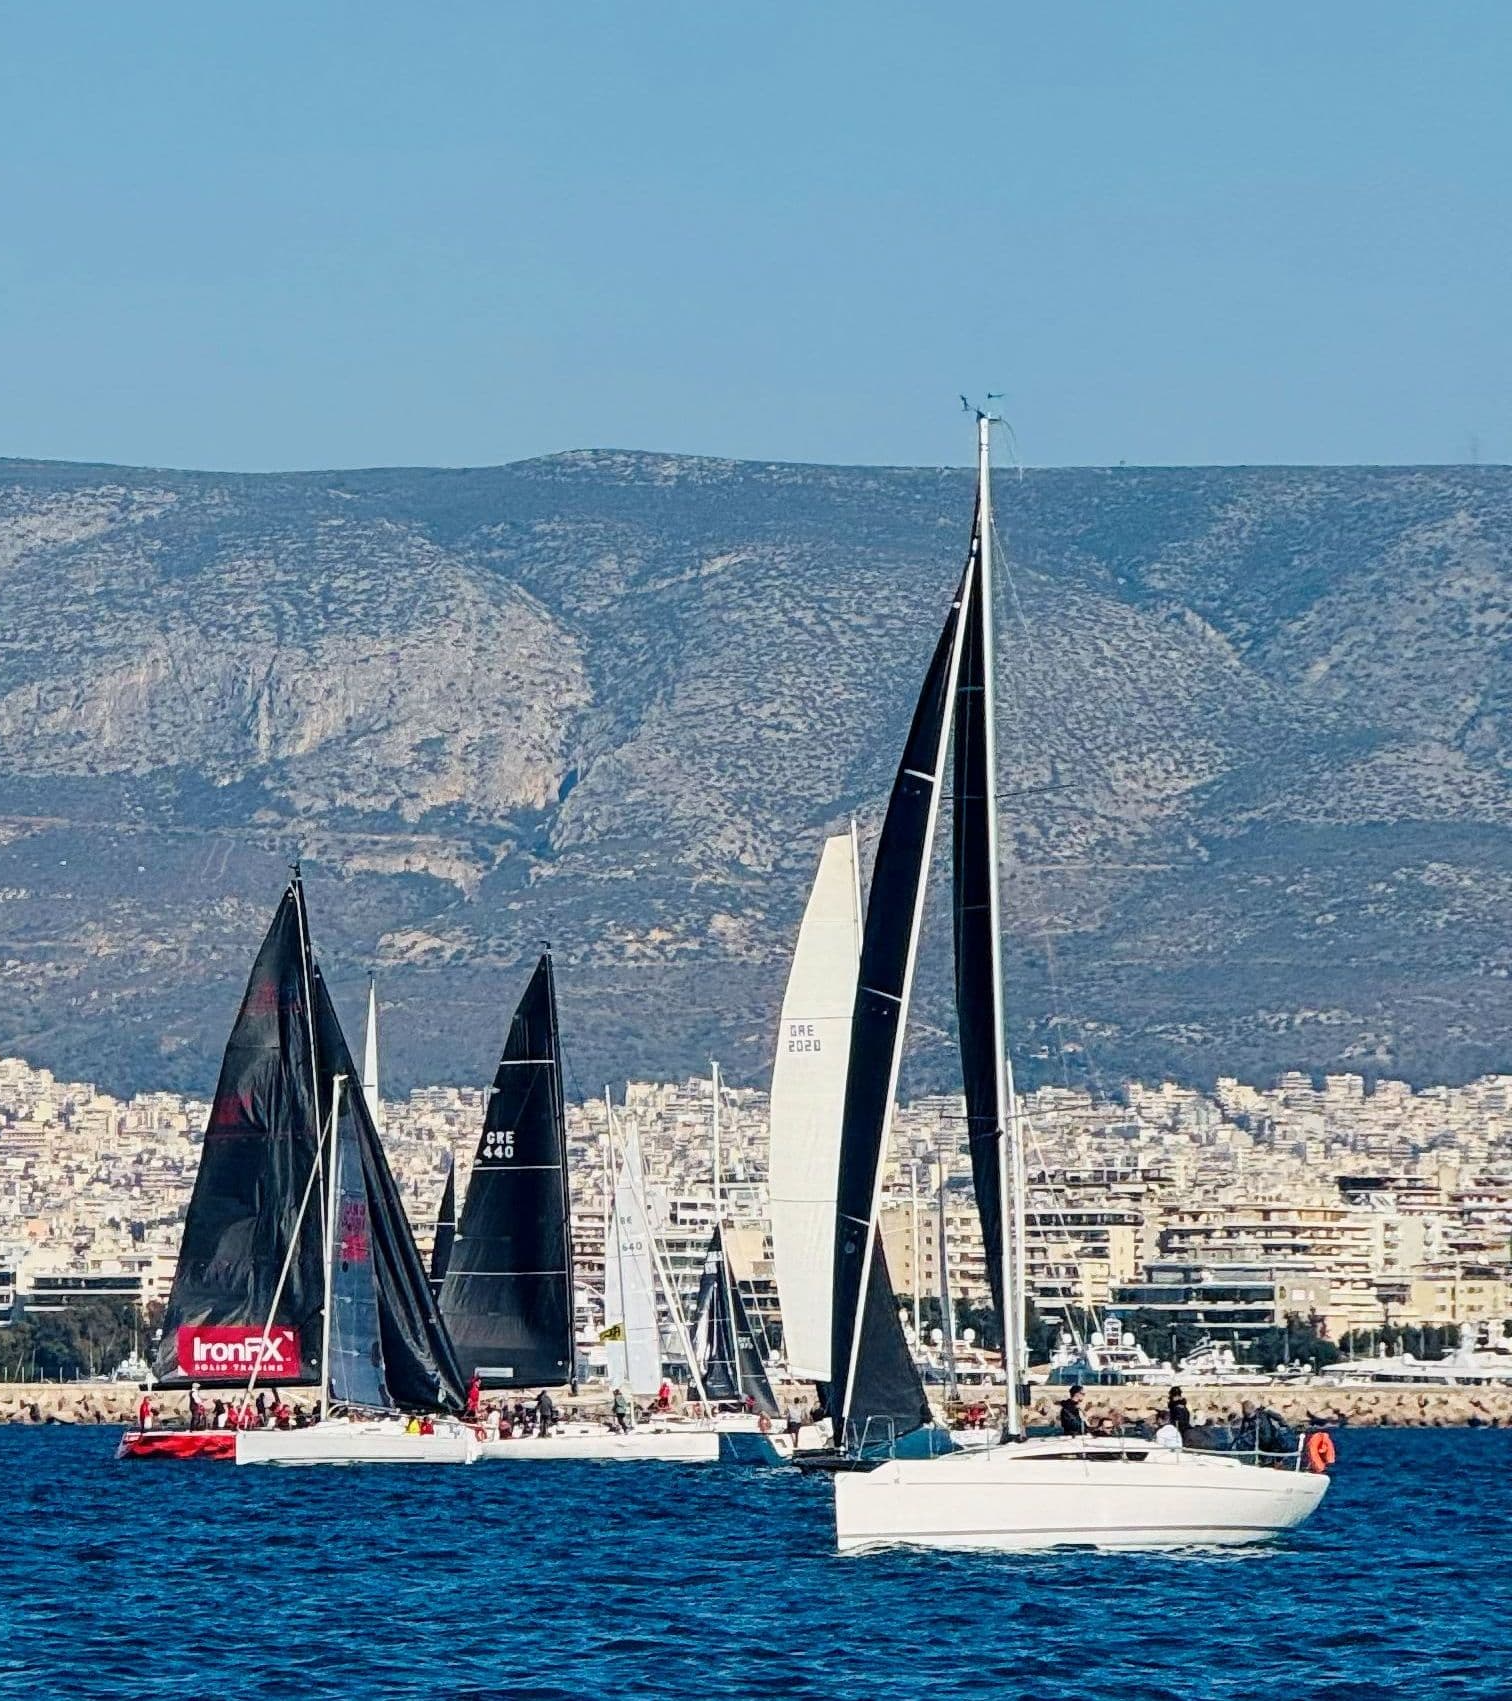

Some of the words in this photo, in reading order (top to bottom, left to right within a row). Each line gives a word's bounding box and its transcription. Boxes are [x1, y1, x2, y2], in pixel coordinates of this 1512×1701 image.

[790, 1024, 814, 1036] GRE
[788, 1040, 821, 1052] 2020
[486, 1131, 515, 1144] GRE
[483, 1145, 514, 1159] 440
[193, 1336, 284, 1362] IronFX
[194, 1363, 228, 1371] SOLID
